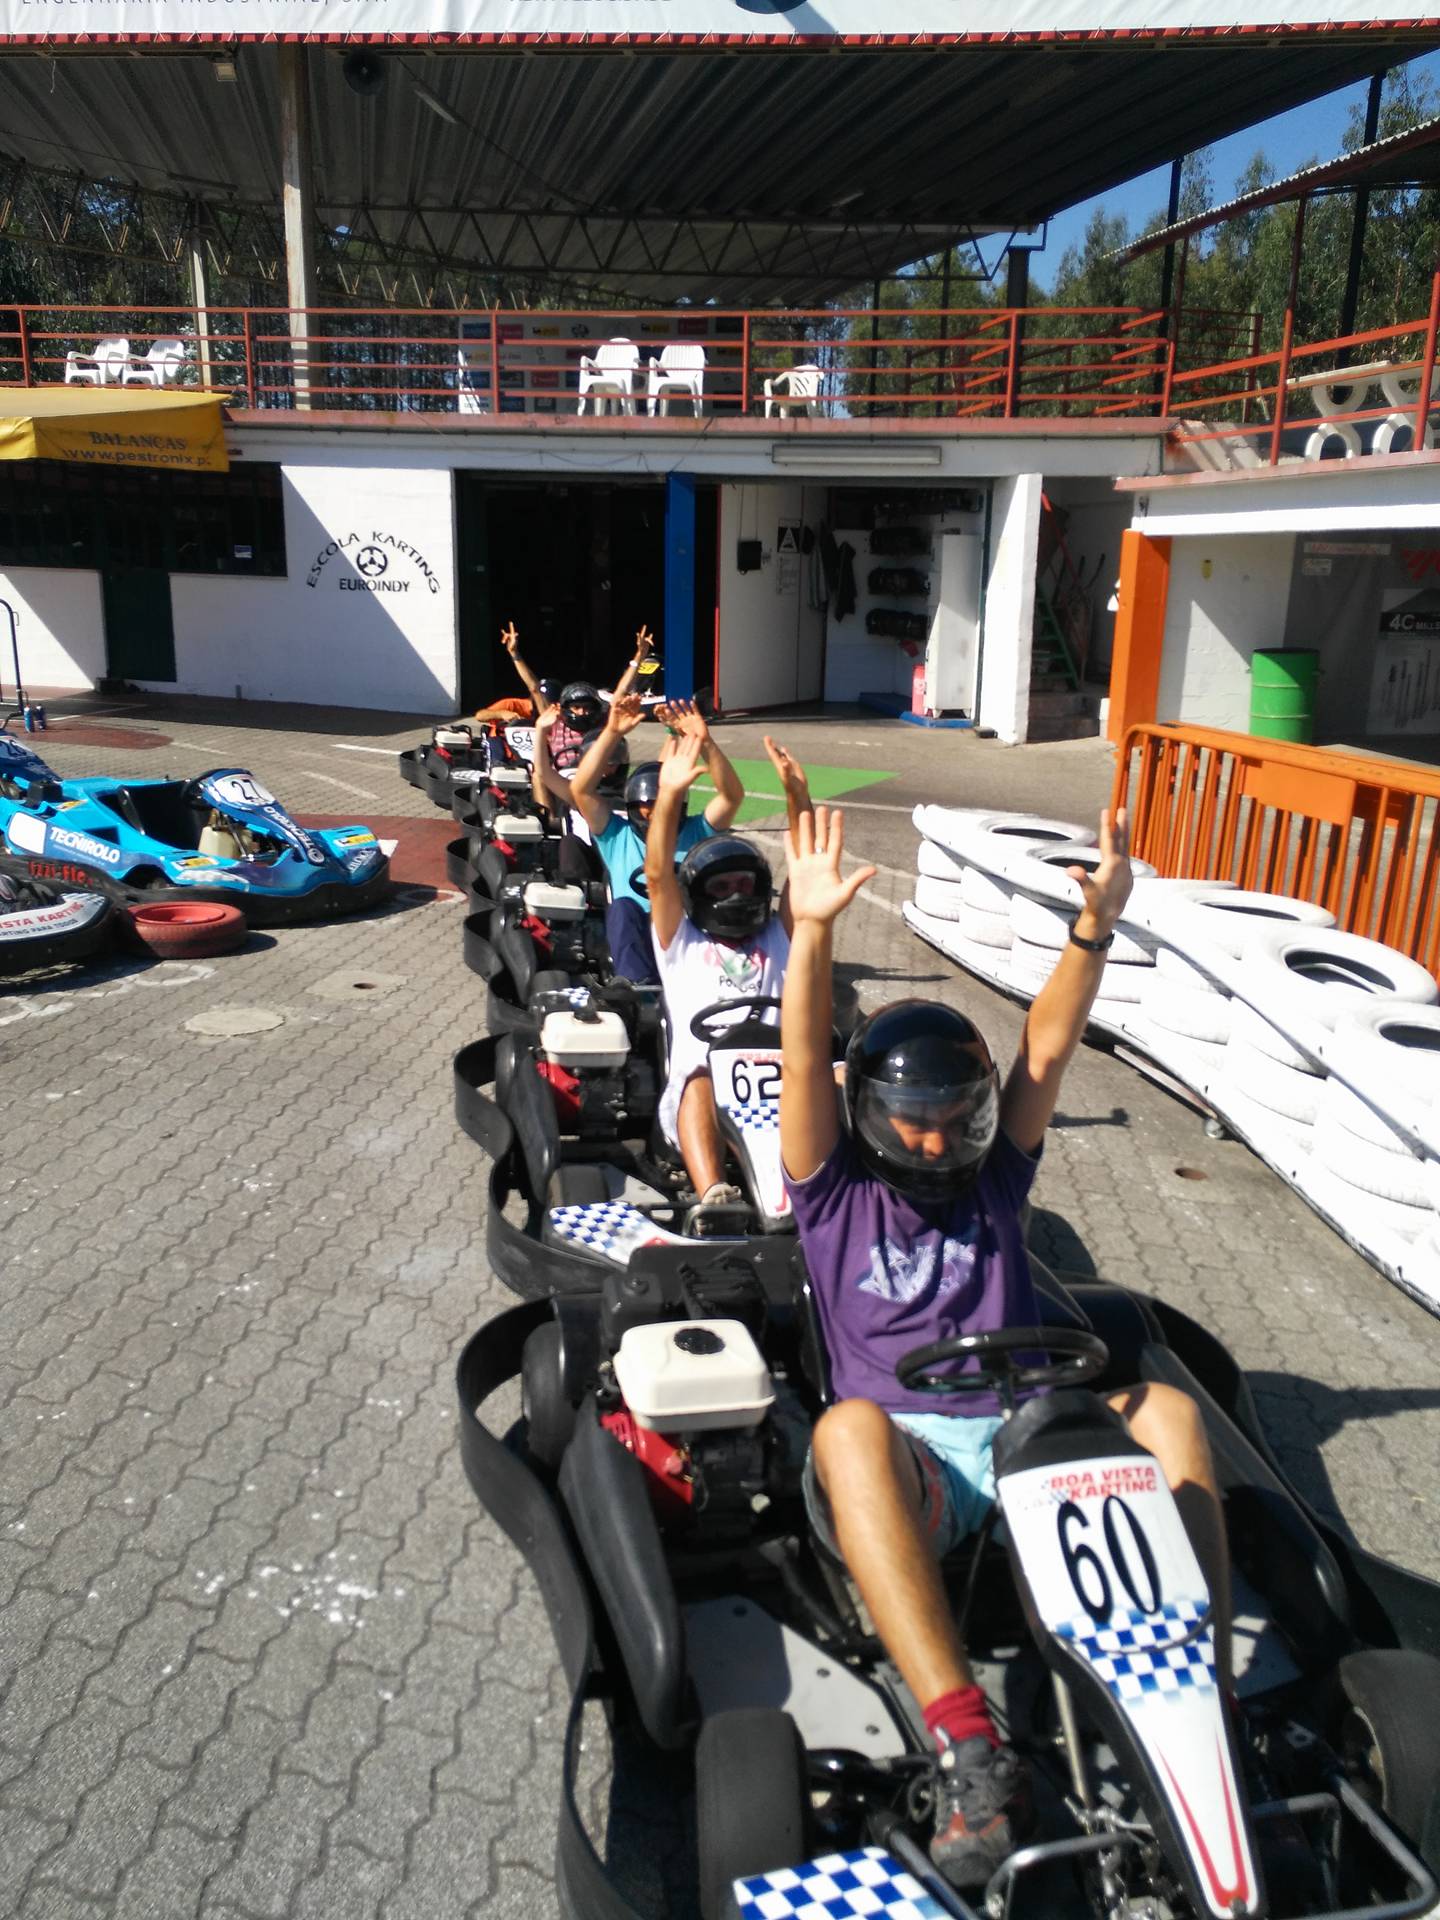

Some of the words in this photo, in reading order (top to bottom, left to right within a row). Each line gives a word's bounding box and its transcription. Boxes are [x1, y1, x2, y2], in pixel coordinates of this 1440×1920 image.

[306, 532, 360, 588] ESCOLA
[372, 531, 440, 594] KARTING
[339, 577, 410, 592] EUROINDY
[511, 731, 534, 745] 64
[231, 778, 272, 805] 27
[49, 826, 121, 864] TECNIROLO
[732, 1058, 782, 1103] 62
[1050, 1471, 1094, 1489] BOA
[1102, 1467, 1157, 1483] VISTA
[1068, 1480, 1158, 1501] KARTING
[1057, 1495, 1163, 1624] 60
